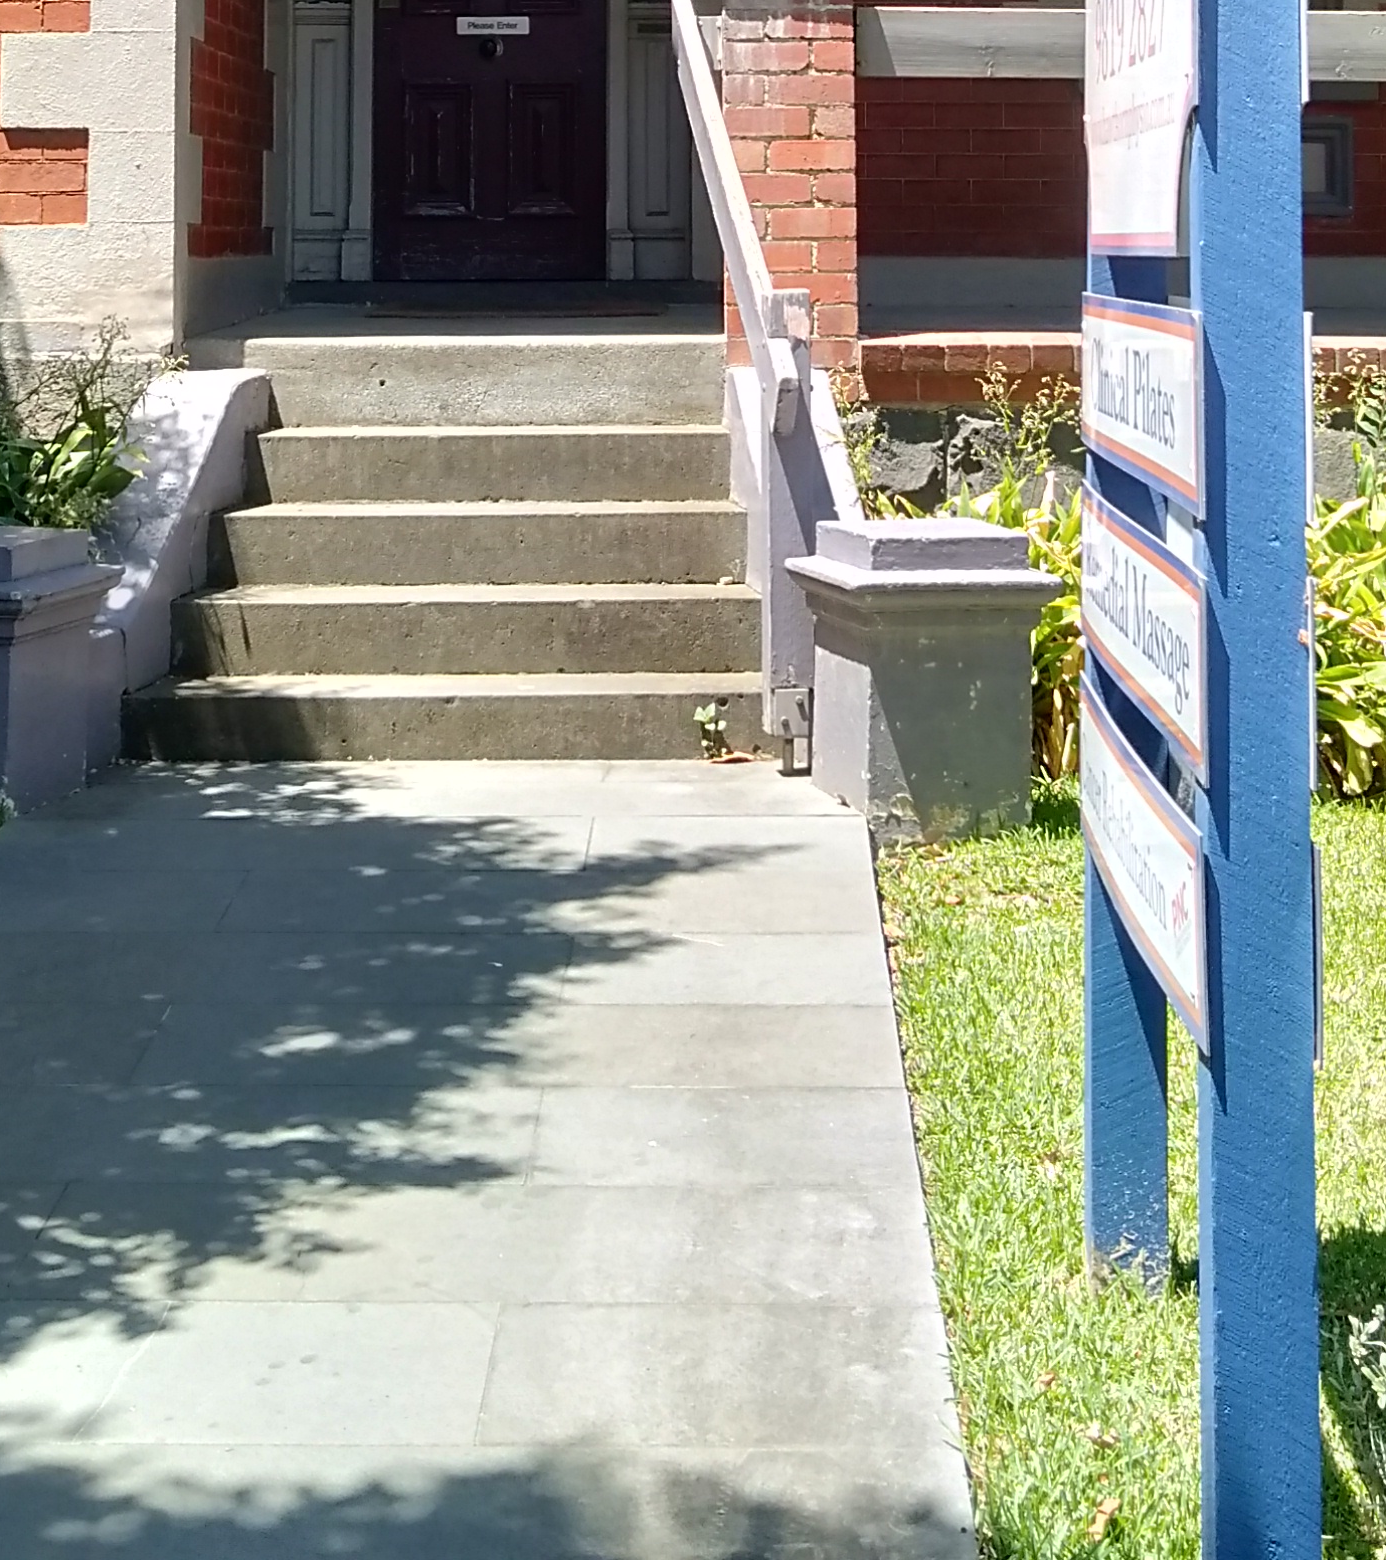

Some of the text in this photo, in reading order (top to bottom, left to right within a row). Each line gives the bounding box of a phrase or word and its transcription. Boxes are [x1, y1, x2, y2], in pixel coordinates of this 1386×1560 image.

[467, 21, 519, 30] Please Enter
[1091, 336, 1176, 450] Clinical Pilates
[1132, 564, 1190, 716] Massage
